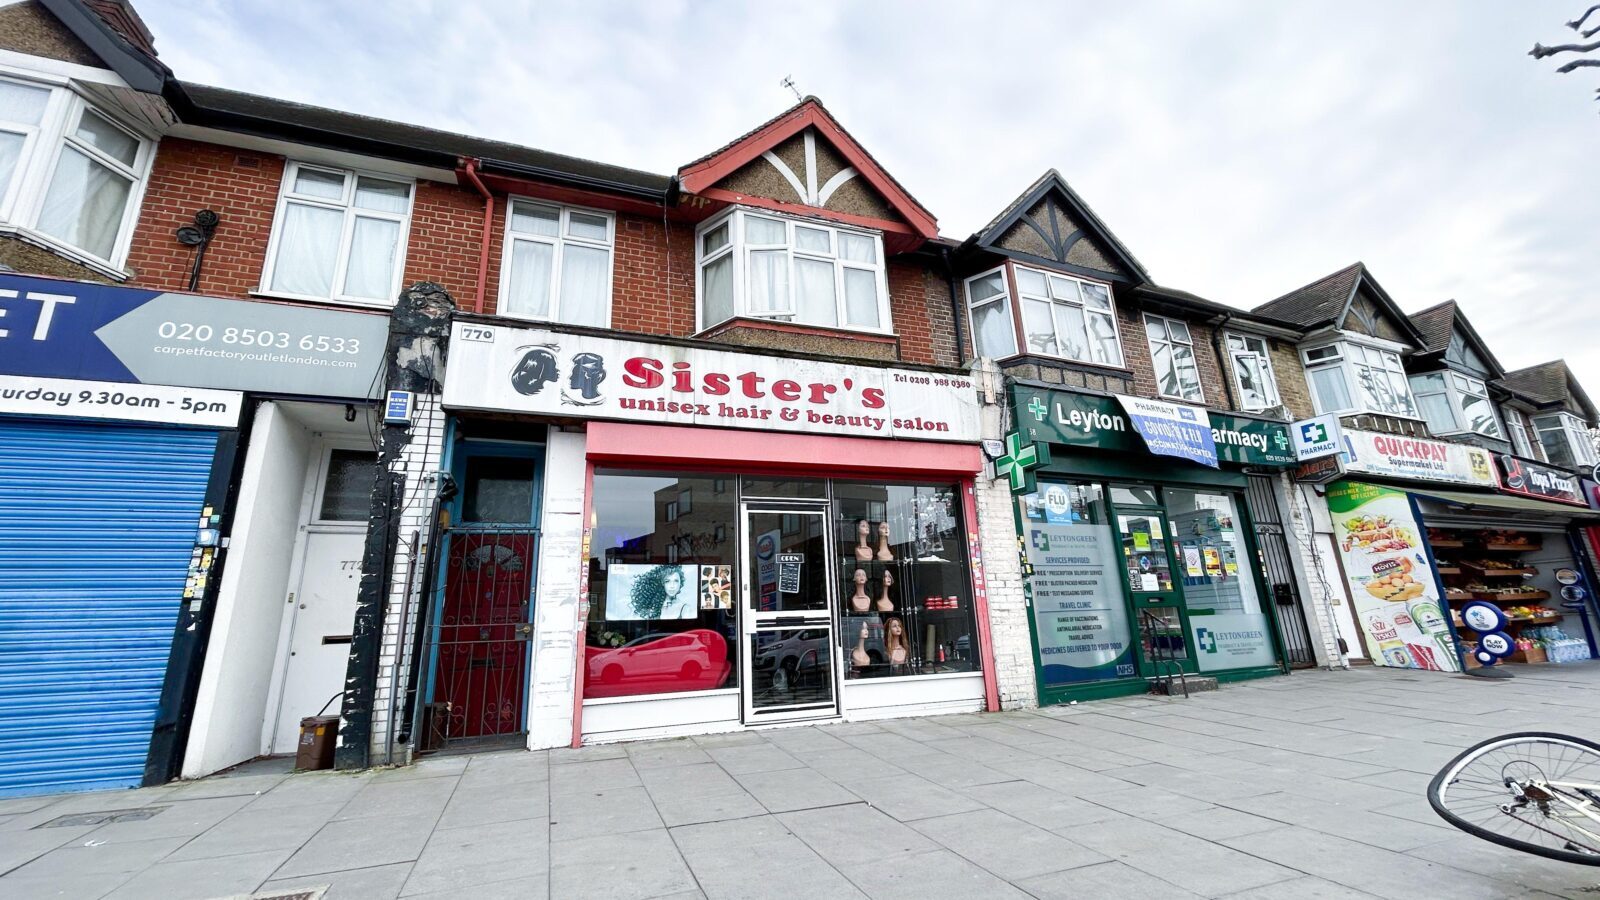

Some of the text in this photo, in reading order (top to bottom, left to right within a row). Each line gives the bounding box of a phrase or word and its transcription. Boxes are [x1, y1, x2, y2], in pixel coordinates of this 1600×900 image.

[158, 321, 360, 355] 020 8503 6533
[463, 328, 493, 340] 770
[153, 344, 357, 368] carpetfactoryoutletlondon.com
[622, 356, 886, 410] Sister's
[893, 373, 971, 389] Tel 0208 988 0380
[0, 387, 72, 406] urday
[78, 390, 160, 408] 9.30am
[180, 397, 227, 414] 5pm
[619, 397, 949, 432] unisex hair & beauty salon
[1134, 402, 1175, 415] PHARMACY
[1056, 402, 1125, 433] Leyton
[1300, 442, 1336, 456] PHARMACY
[1374, 436, 1448, 462] QUICKPAY
[1296, 457, 1336, 479] Mars
[1388, 456, 1445, 471] Supermarket Ltd
[1526, 466, 1574, 494] Tops Pizza
[1048, 494, 1066, 505] FLU
[1050, 534, 1097, 543] LEYTONGREEN
[1045, 556, 1068, 564] SERVICES
[1373, 561, 1397, 572] HOVIS
[1216, 631, 1263, 641] LEYTONGREEN
[1040, 646, 1065, 655] MEDICINES
[1066, 644, 1089, 654] DELIVERED
[1096, 643, 1107, 651] YOUR
[1108, 642, 1122, 650] DOOR
[1118, 665, 1133, 674] NHS
